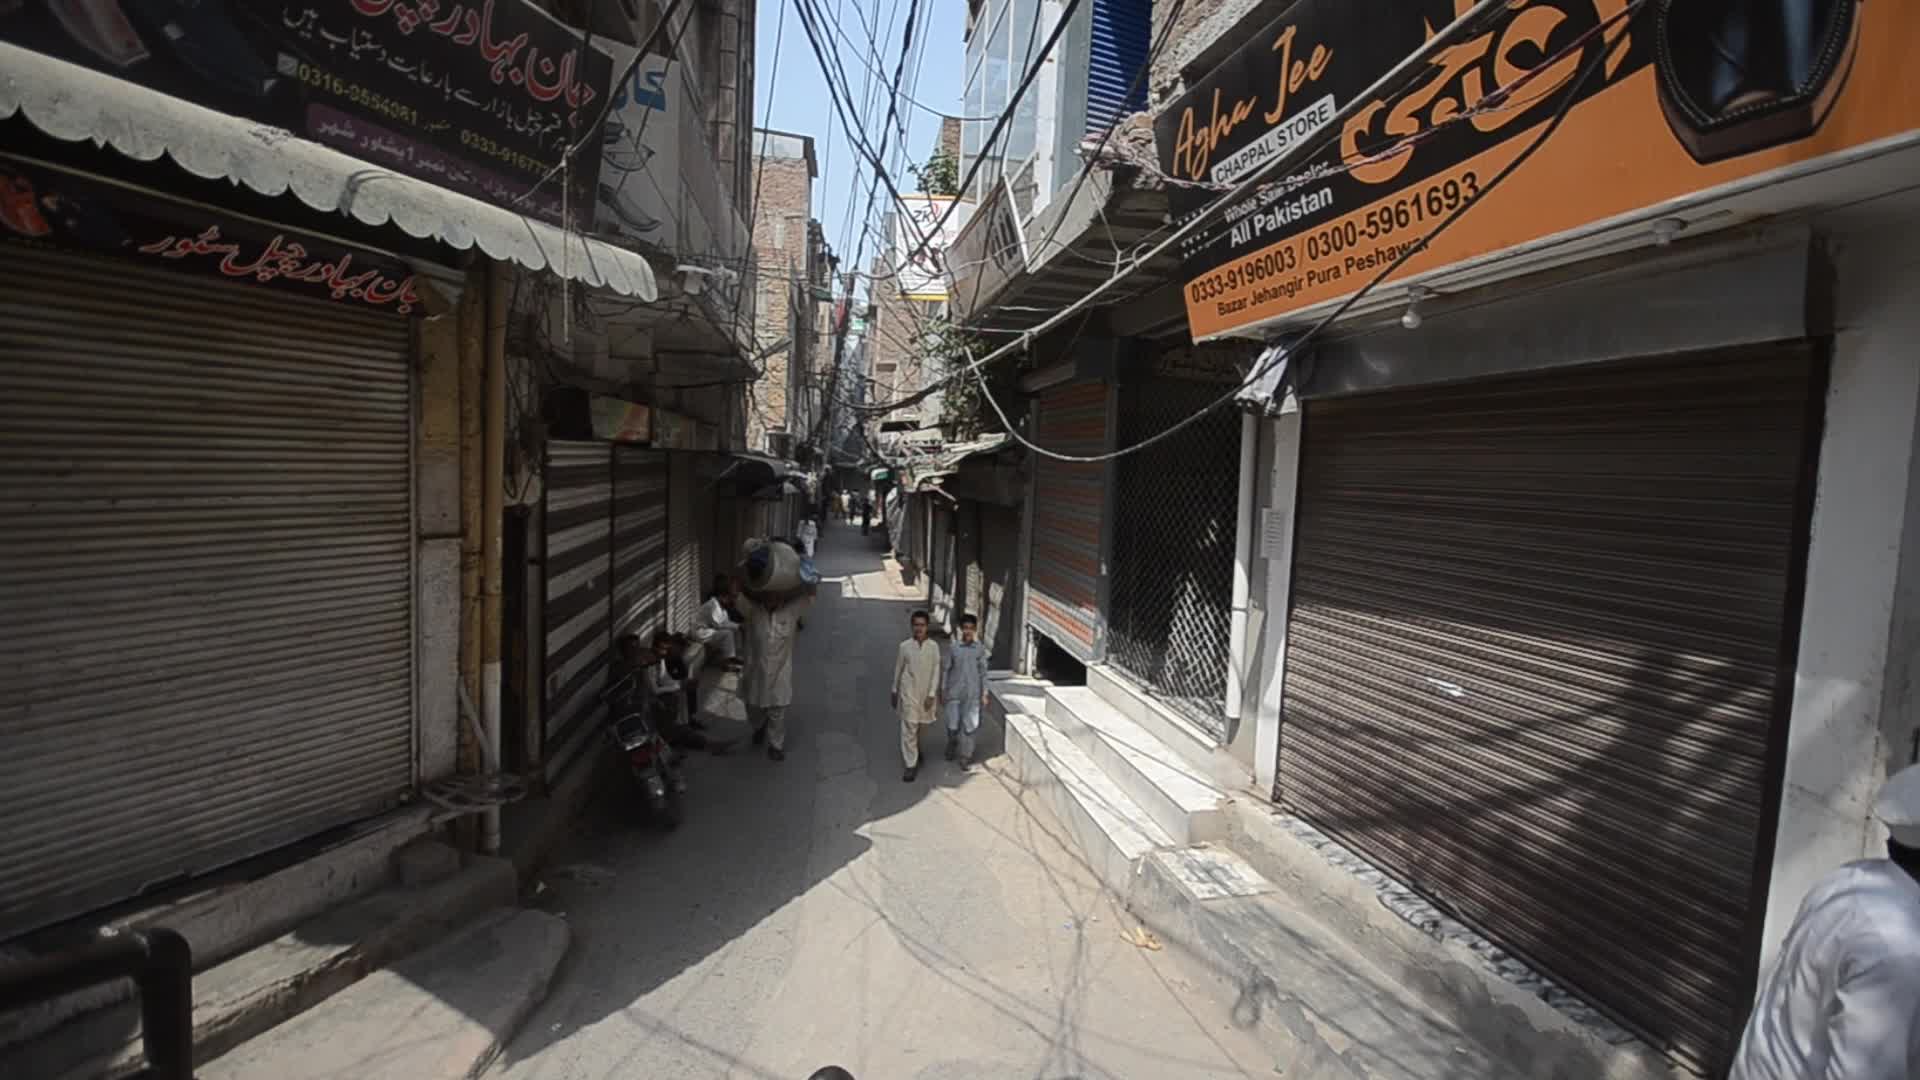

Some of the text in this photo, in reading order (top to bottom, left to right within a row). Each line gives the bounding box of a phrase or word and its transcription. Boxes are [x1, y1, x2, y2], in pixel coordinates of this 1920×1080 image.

[1172, 25, 1333, 181] Agha Jee
[1215, 101, 1331, 184] CHAPPAL STORE
[1192, 246, 1296, 303] 0333-9196003
[1307, 171, 1480, 261] 0300-5961693
[1231, 187, 1332, 248] All Pakistan
[1217, 298, 1247, 316] Bazar
[1251, 276, 1304, 306] Jehangir
[1307, 265, 1341, 287] Pura
